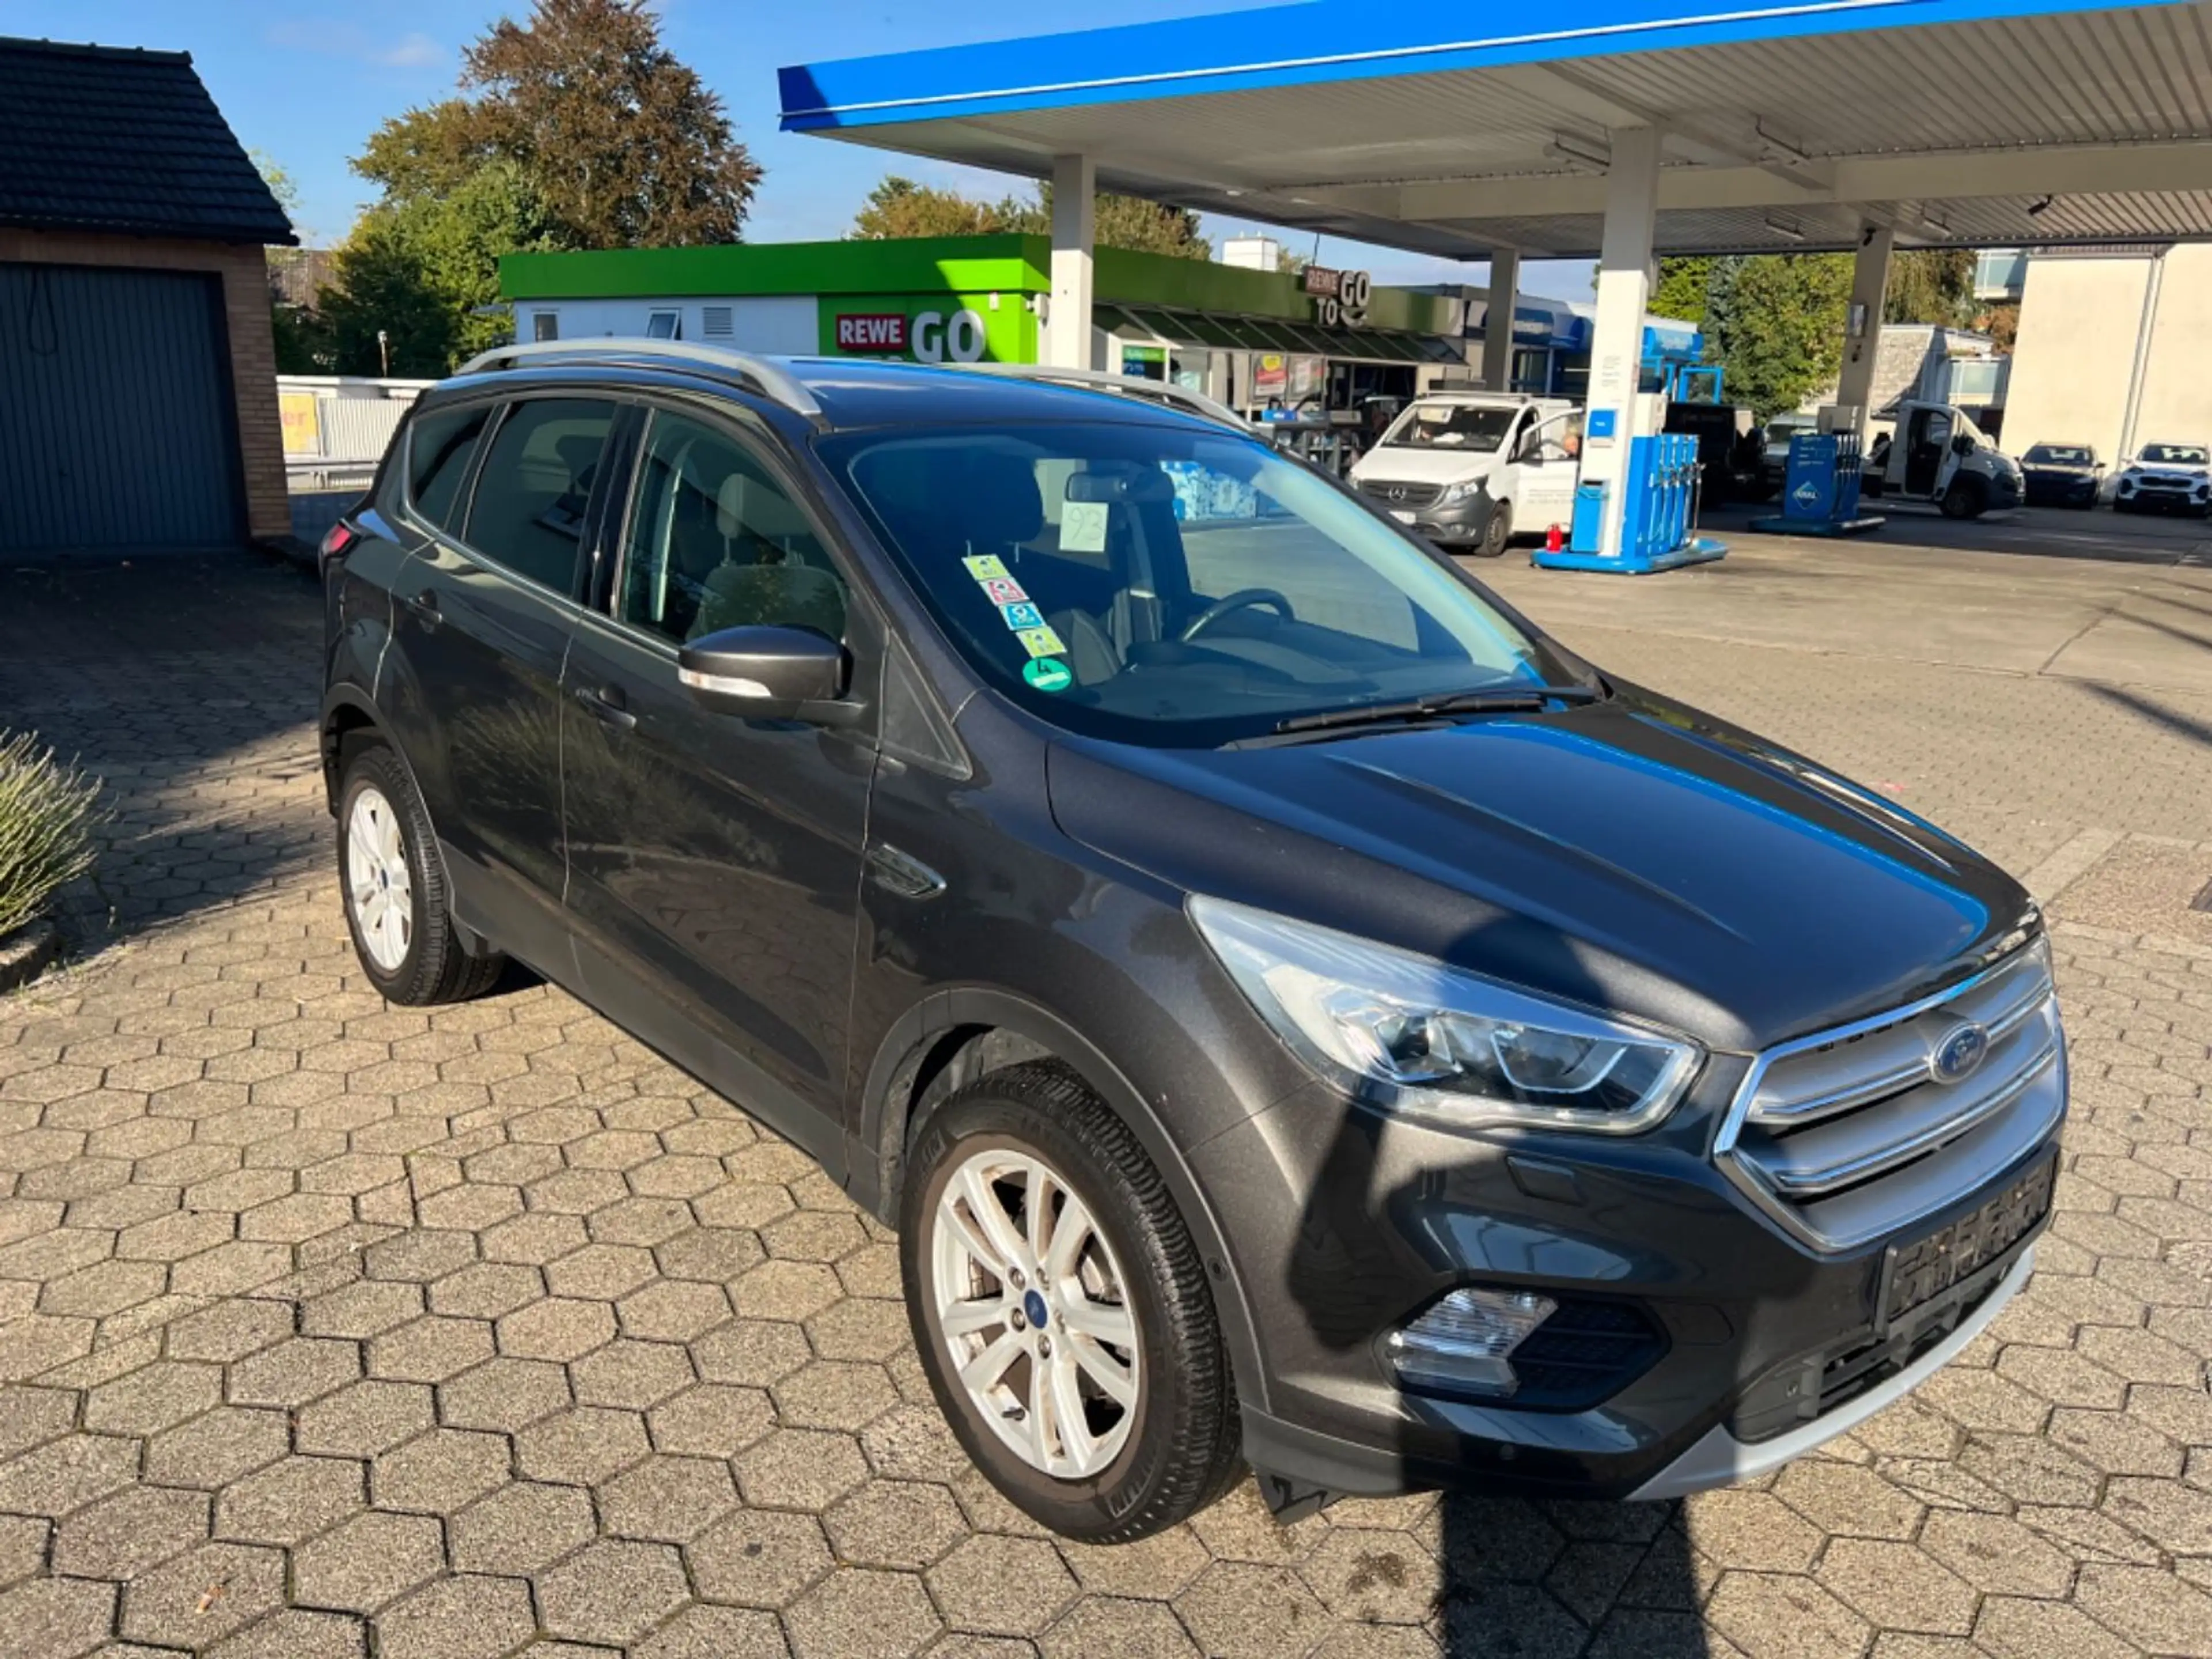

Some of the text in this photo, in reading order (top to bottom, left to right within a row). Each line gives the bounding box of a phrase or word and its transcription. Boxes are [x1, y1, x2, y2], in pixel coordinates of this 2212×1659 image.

[1340, 270, 1370, 307] GO
[1316, 298, 1337, 325] TO
[839, 310, 986, 363] REWE GO
[1068, 507, 1104, 541] 93
